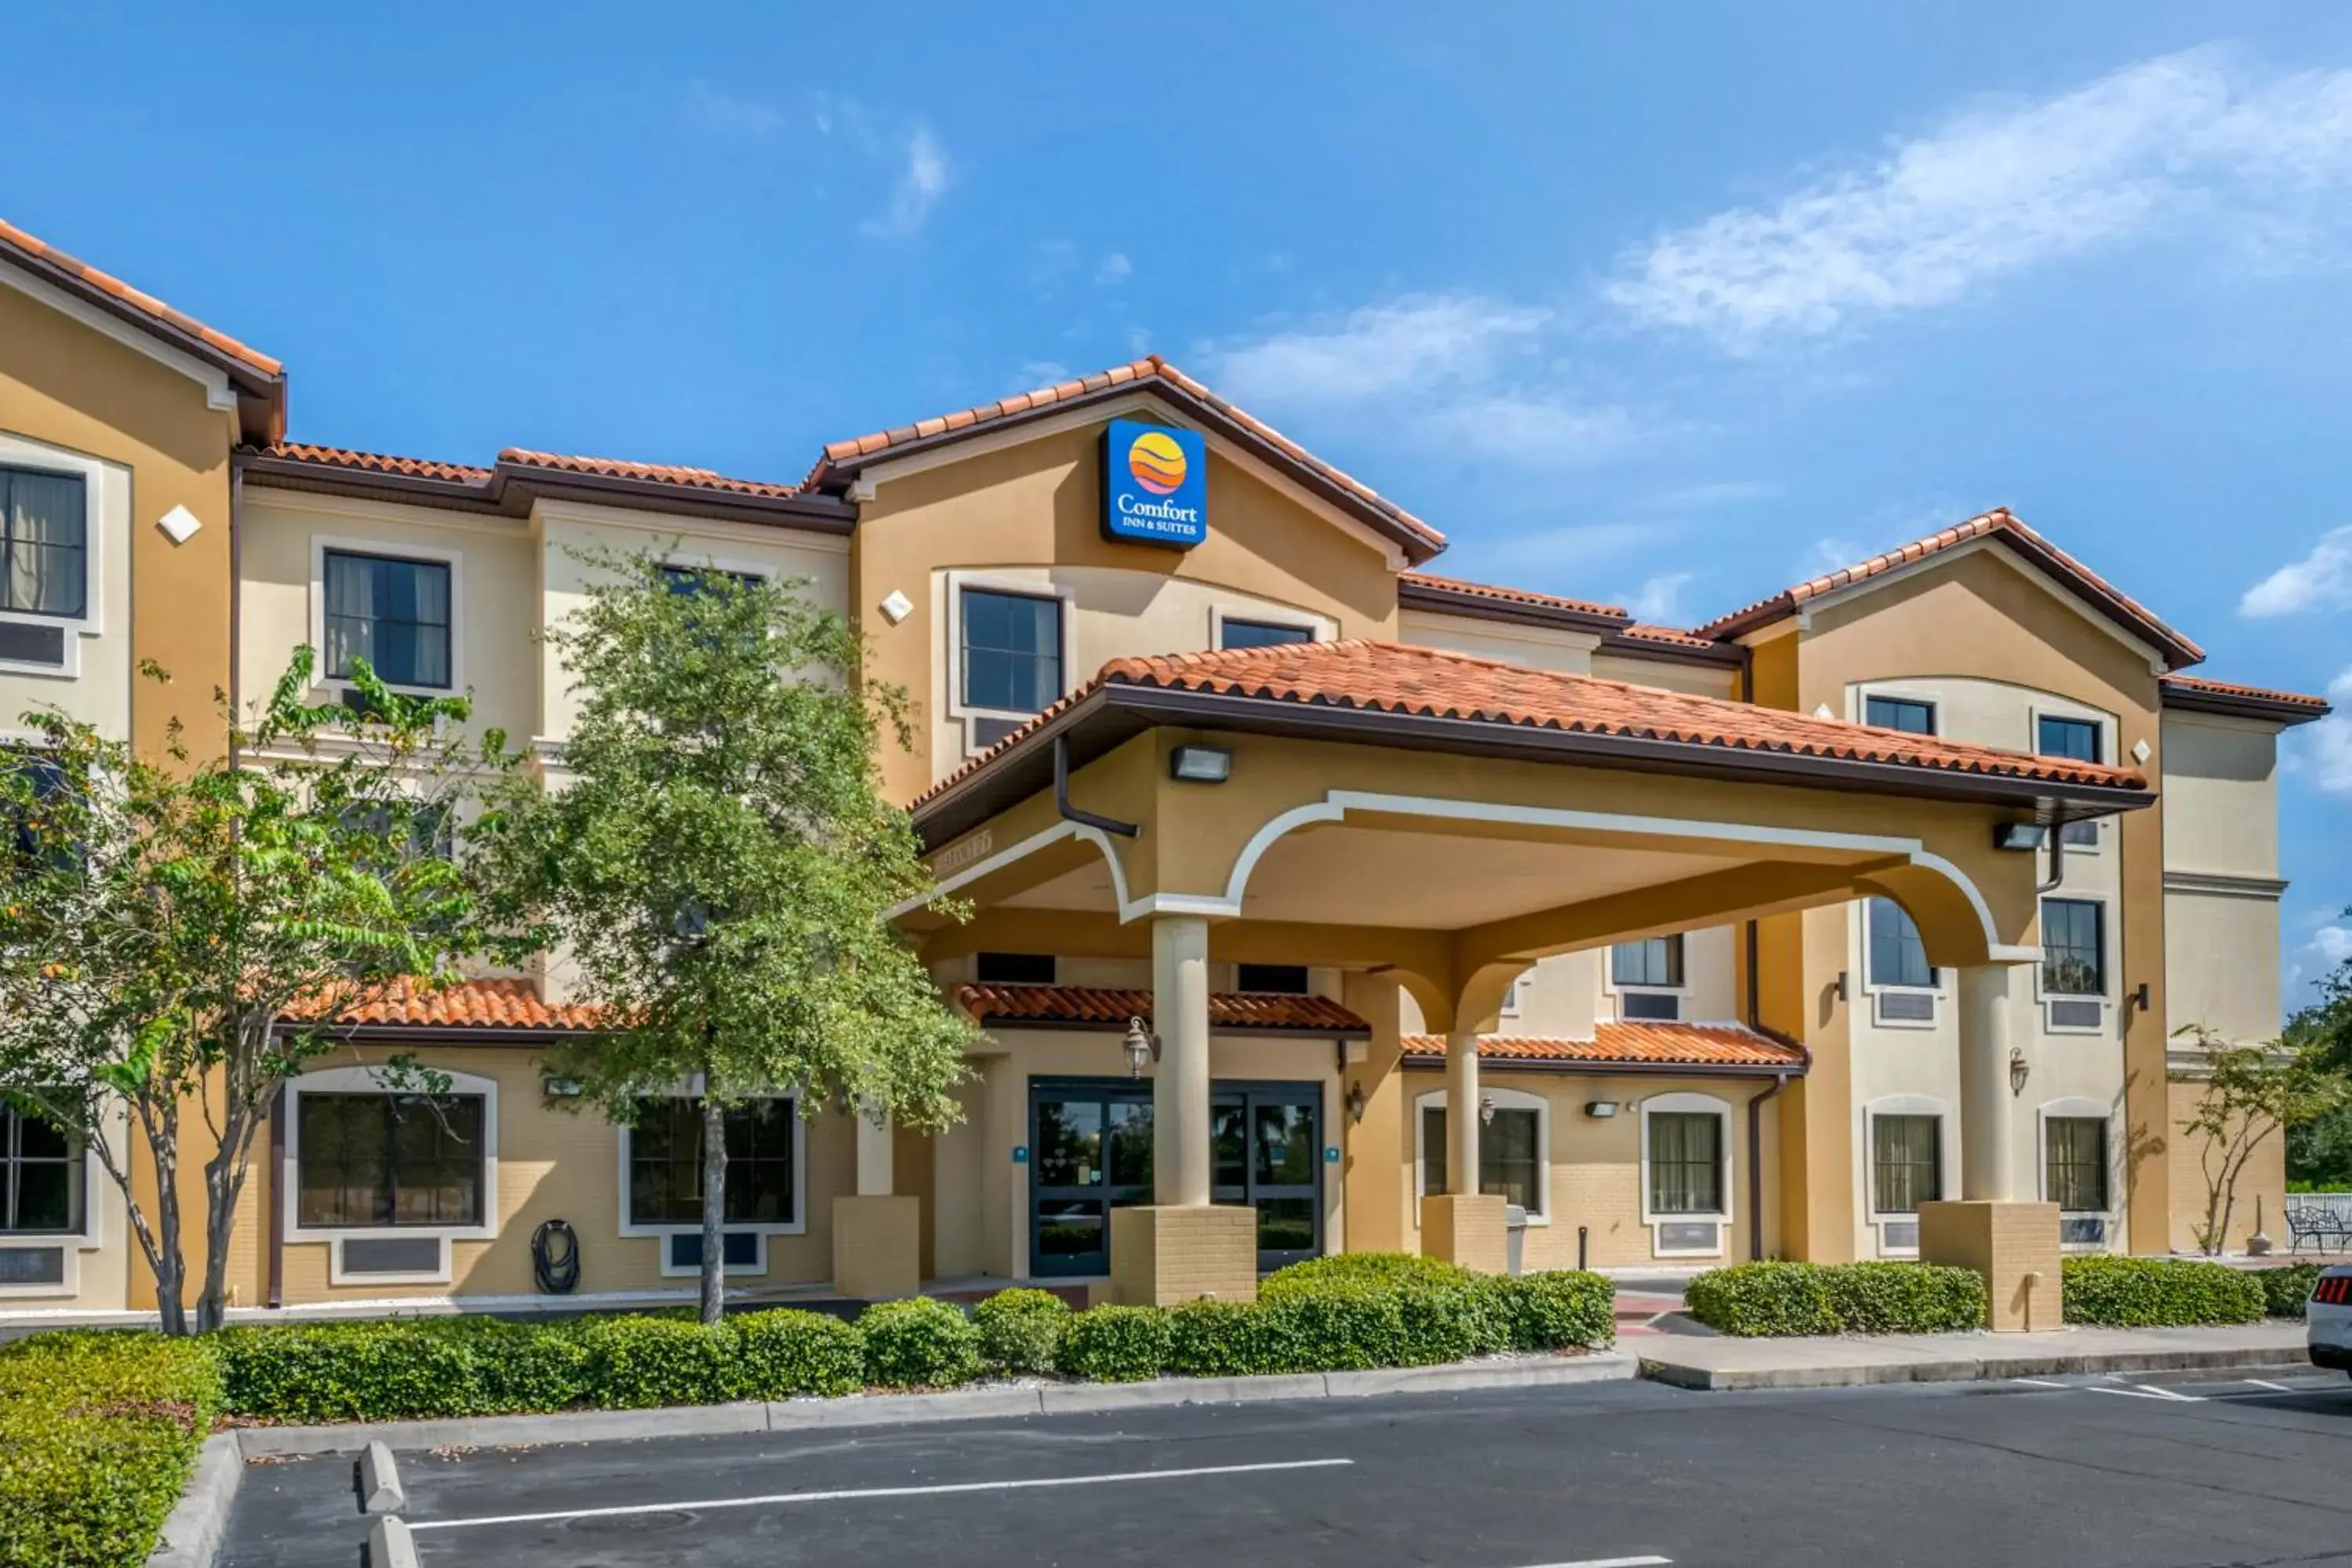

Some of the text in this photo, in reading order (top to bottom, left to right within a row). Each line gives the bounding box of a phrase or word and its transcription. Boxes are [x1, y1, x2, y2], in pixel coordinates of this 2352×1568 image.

[1117, 493, 1197, 522] Comfort
[1123, 517, 1197, 535] INN & SUITES
